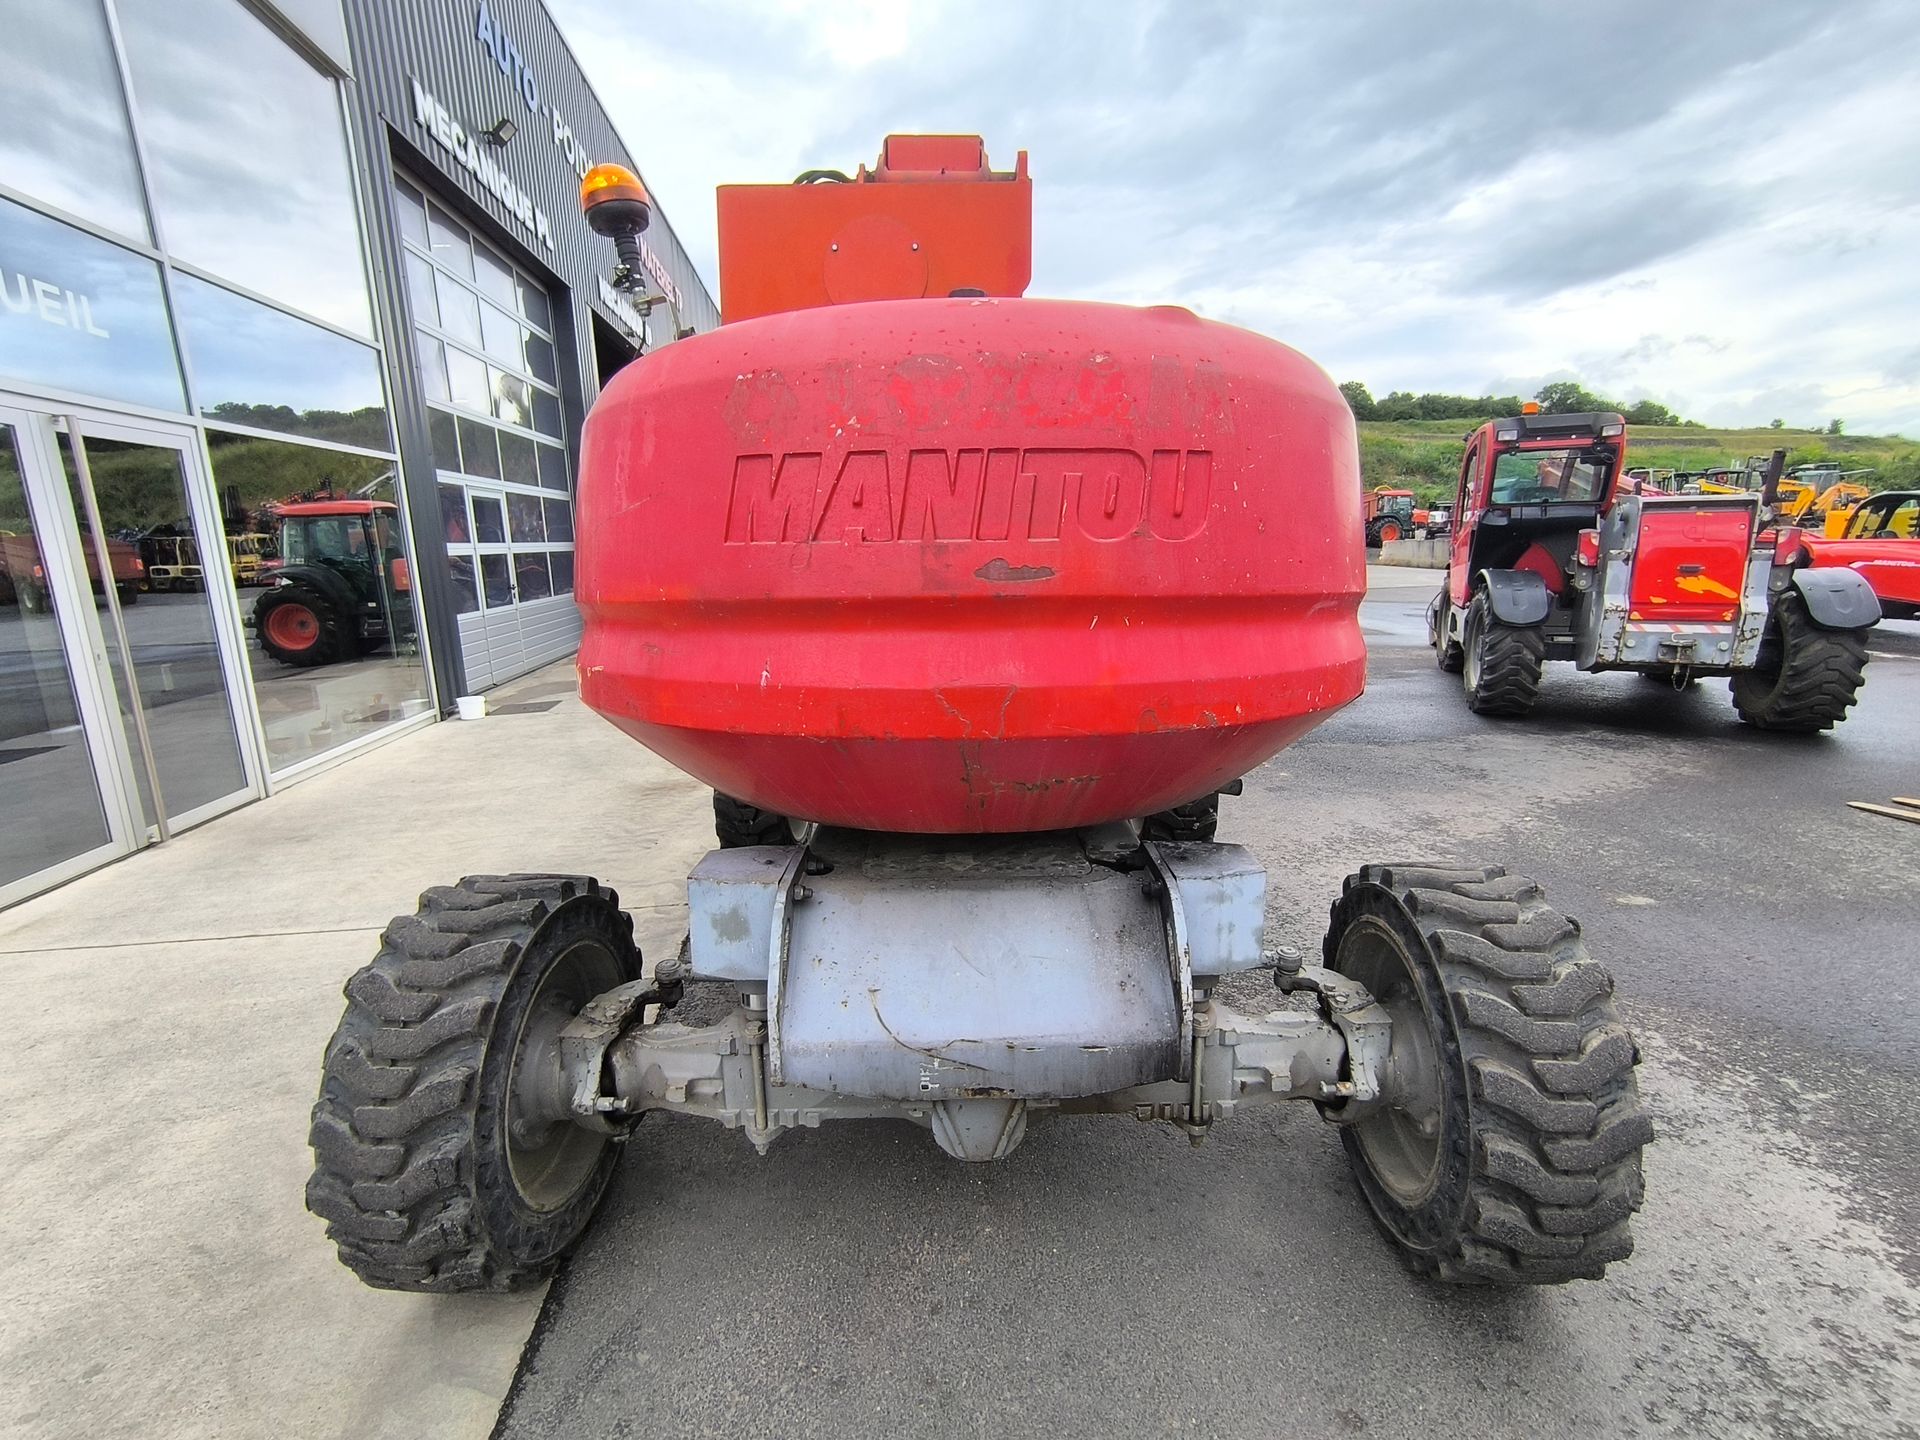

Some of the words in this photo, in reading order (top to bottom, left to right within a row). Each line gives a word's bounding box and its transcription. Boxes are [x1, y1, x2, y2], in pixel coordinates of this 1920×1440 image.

[413, 75, 534, 231] MECANIQUE
[475, 2, 539, 113] AUTO
[552, 105, 594, 180] POID
[723, 446, 1214, 545] MANITOU
